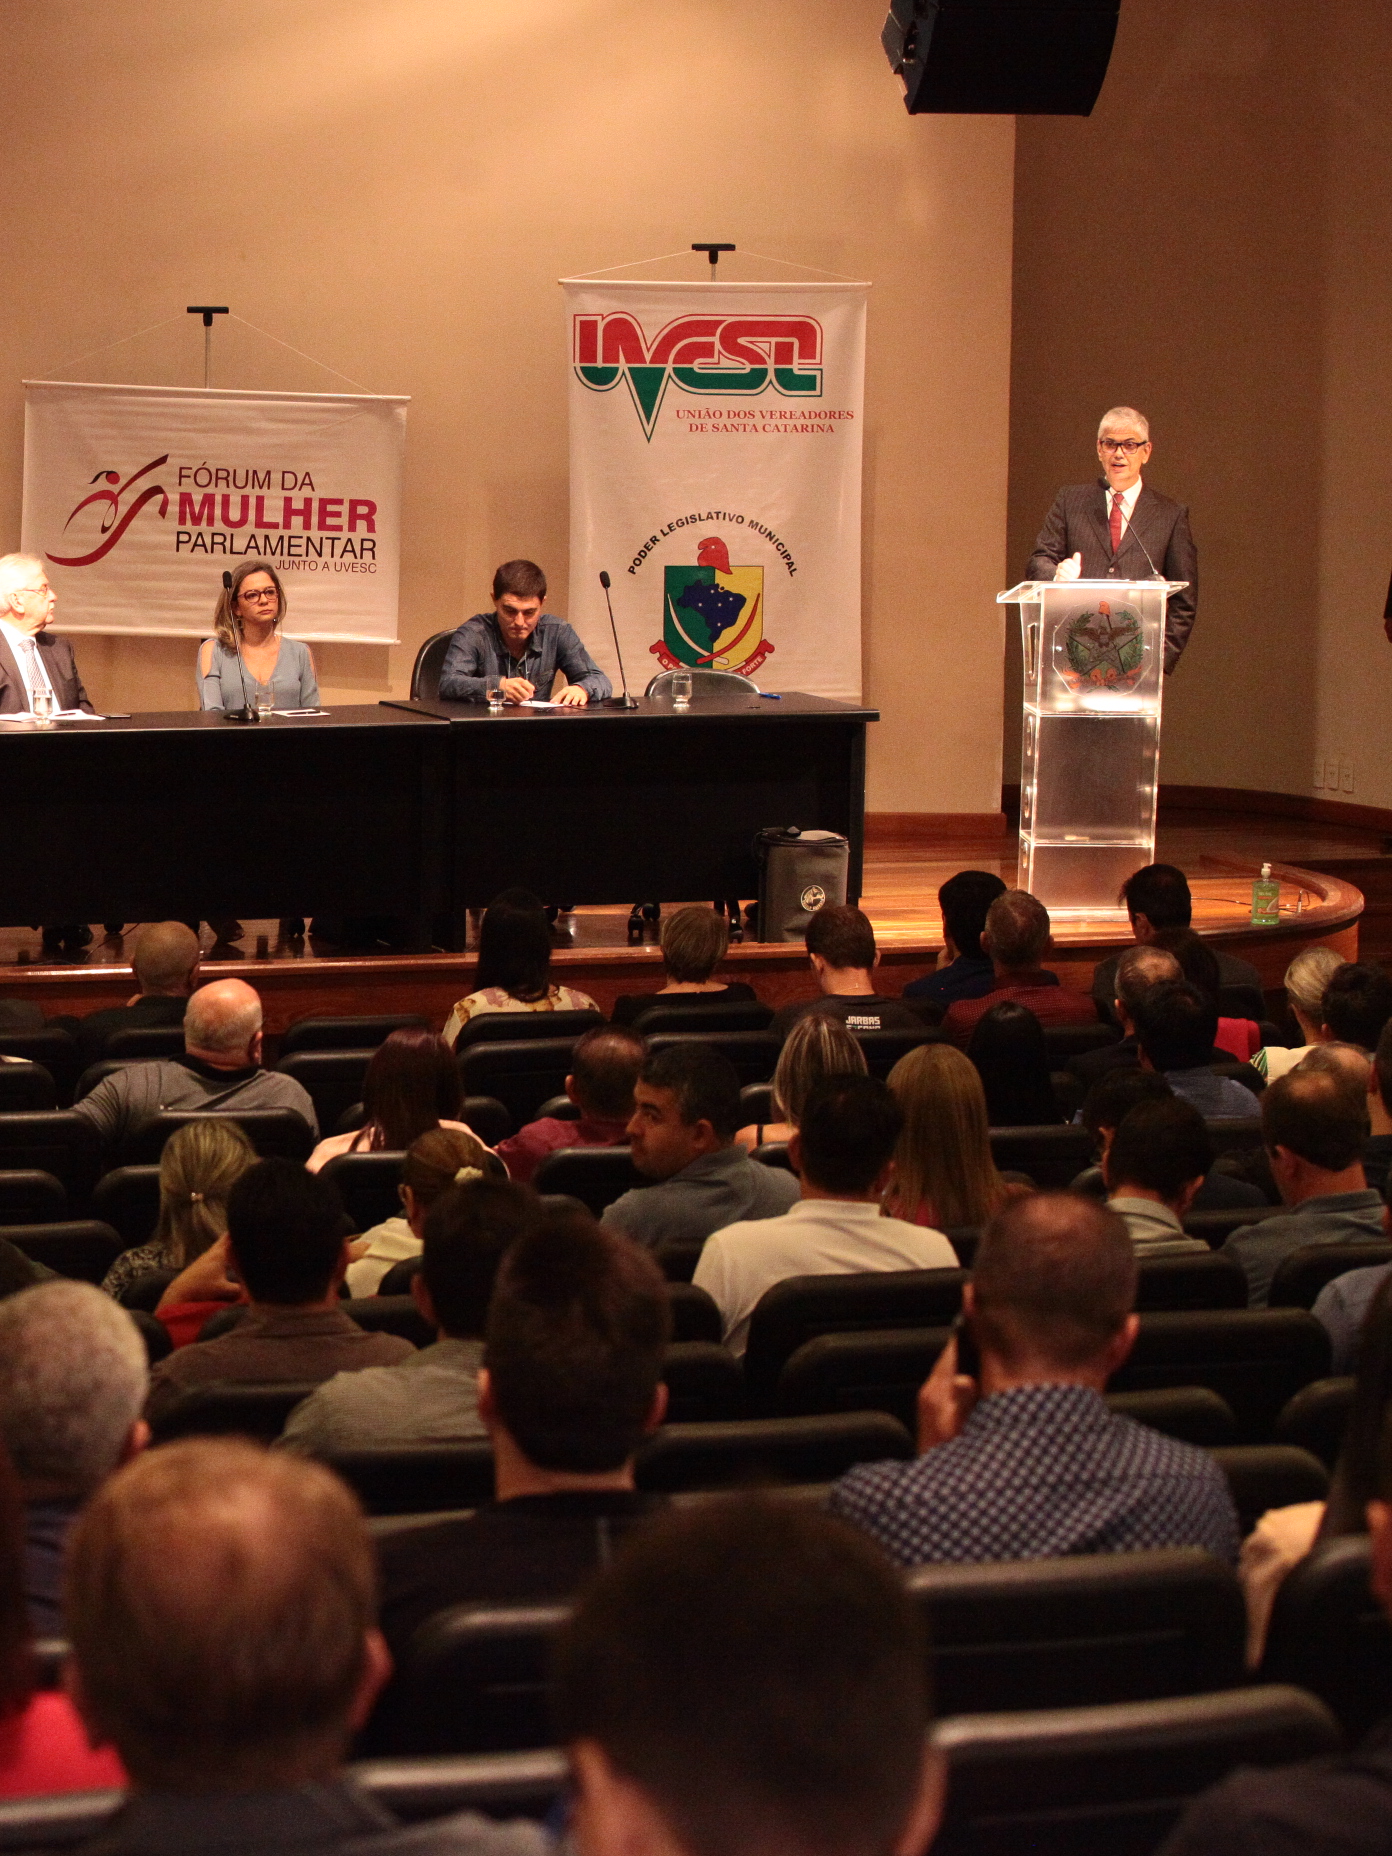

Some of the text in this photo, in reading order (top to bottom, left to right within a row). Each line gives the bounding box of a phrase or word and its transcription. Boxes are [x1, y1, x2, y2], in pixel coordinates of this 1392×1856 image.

[675, 407, 854, 420] UNIÃO DOS VEREADORES
[688, 422, 835, 433] DE SANTA CATARINA
[177, 461, 315, 492] FÓRUM DA
[177, 491, 378, 534] MULHER
[175, 530, 377, 560] PARLAMENTAR
[627, 511, 798, 577] PODER LEGISLATIVO MUNICIPAL
[275, 559, 378, 574] JUNTO A UVESC
[741, 655, 765, 676] FORTE
[845, 1015, 881, 1026] JARBAS
